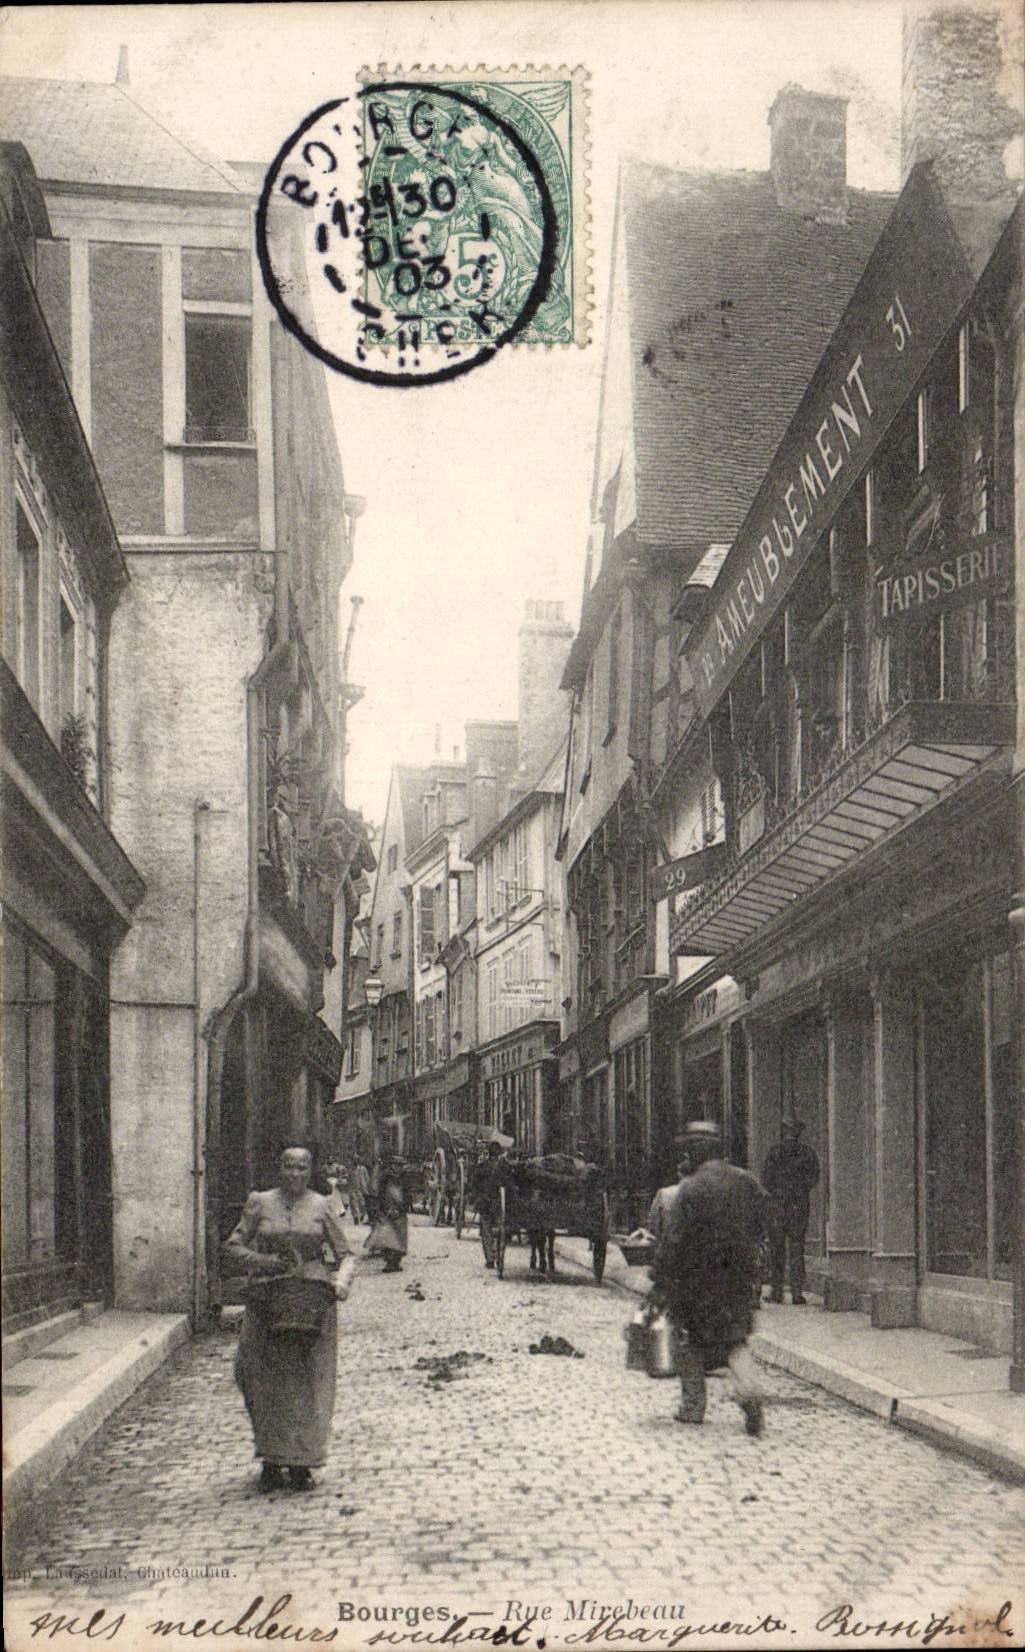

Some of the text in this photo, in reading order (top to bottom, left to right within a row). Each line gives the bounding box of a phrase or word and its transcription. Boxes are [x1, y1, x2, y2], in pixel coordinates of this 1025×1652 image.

[715, 354, 873, 667] AMEUBLEMENT
[885, 294, 912, 351] 31
[664, 867, 687, 891] 29
